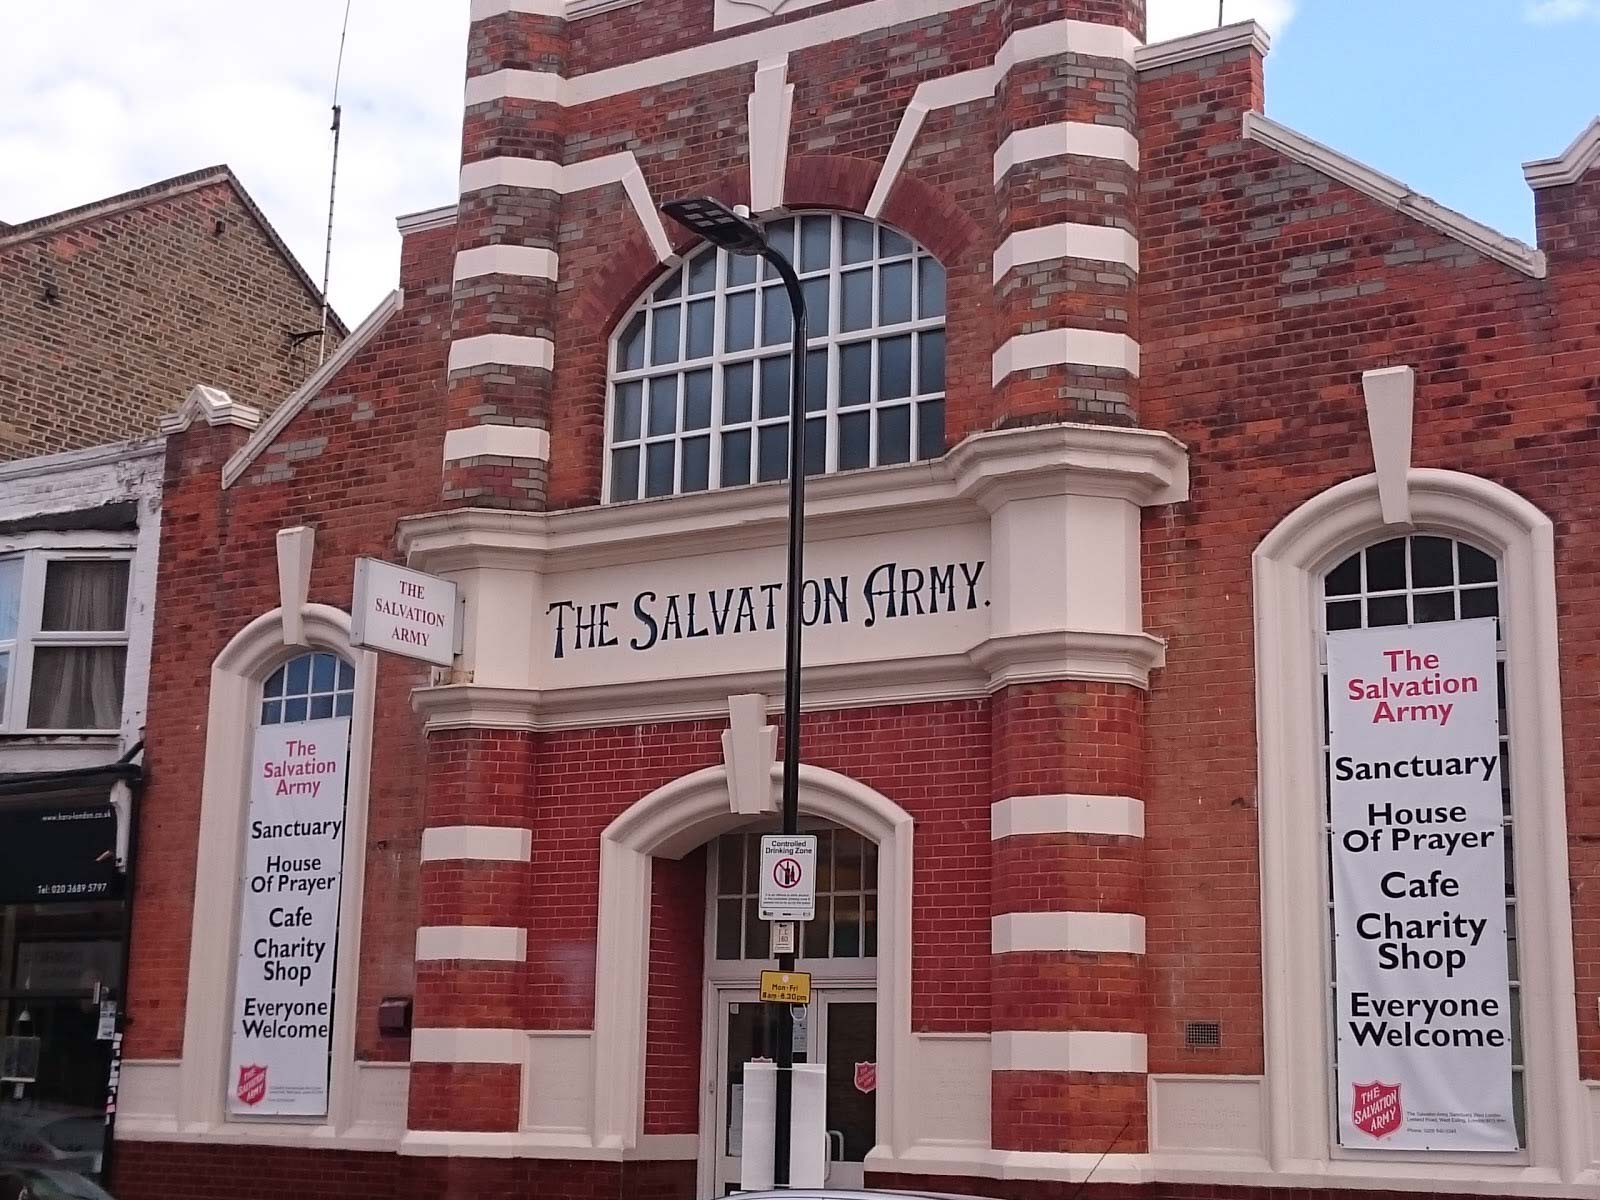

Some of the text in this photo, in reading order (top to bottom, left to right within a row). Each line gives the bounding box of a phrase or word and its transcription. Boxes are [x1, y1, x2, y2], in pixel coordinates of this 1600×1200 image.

[400, 580, 425, 600] THE
[375, 598, 445, 628] SALVATION
[546, 600, 618, 659] THE
[630, 576, 849, 651] SALVATON
[391, 626, 430, 647] ARMY
[1383, 650, 1439, 672] The
[1348, 673, 1478, 701] Salvation
[1372, 701, 1453, 725] Army
[286, 740, 316, 757] The
[263, 758, 336, 778] Salvation
[1335, 755, 1497, 781] Sanctuary
[275, 779, 321, 798] Army
[1368, 803, 1467, 826] House
[251, 820, 342, 840] Sanctuary
[1343, 828, 1494, 856] Of Prayer
[765, 847, 794, 855] Drinking
[266, 855, 322, 873] House
[38, 885, 50, 894] Tel:
[51, 884, 66, 894] 020
[88, 882, 107, 893] 5797
[251, 874, 336, 896] Of Prayer
[1380, 870, 1459, 898] Cafe
[269, 906, 313, 928] Cafe
[1356, 911, 1487, 946] Charity
[254, 937, 326, 963] Charity
[1378, 942, 1466, 977] Shop
[264, 960, 312, 987] Shop
[244, 998, 328, 1022] Everyone
[1351, 992, 1499, 1024] Everyone
[242, 1019, 328, 1039] Welcome
[1348, 1021, 1504, 1047] Welcome
[1354, 1089, 1397, 1125] SALVATION
[1360, 1086, 1380, 1105] THE
[1370, 1107, 1397, 1132] ARMY
